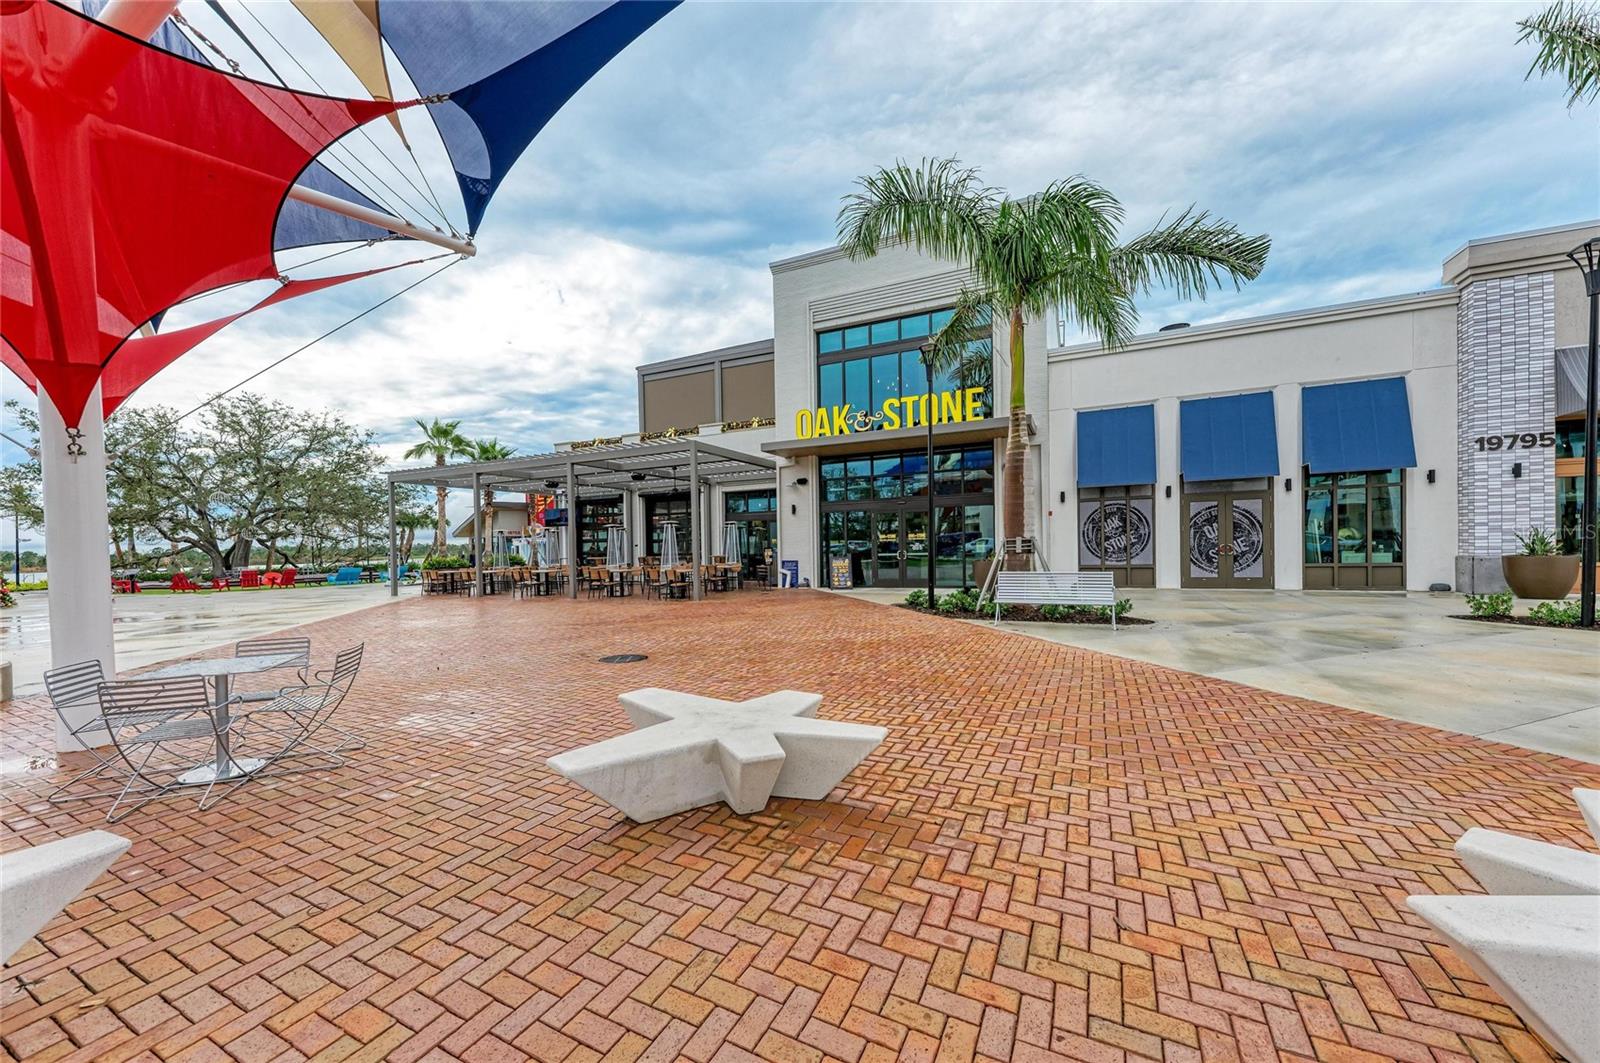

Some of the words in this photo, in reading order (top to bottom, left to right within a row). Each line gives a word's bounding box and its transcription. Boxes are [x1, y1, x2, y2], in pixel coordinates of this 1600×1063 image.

[795, 403, 851, 440] OAK
[846, 410, 884, 432] &
[883, 386, 985, 431] STONE
[1474, 431, 1556, 452] 19795
